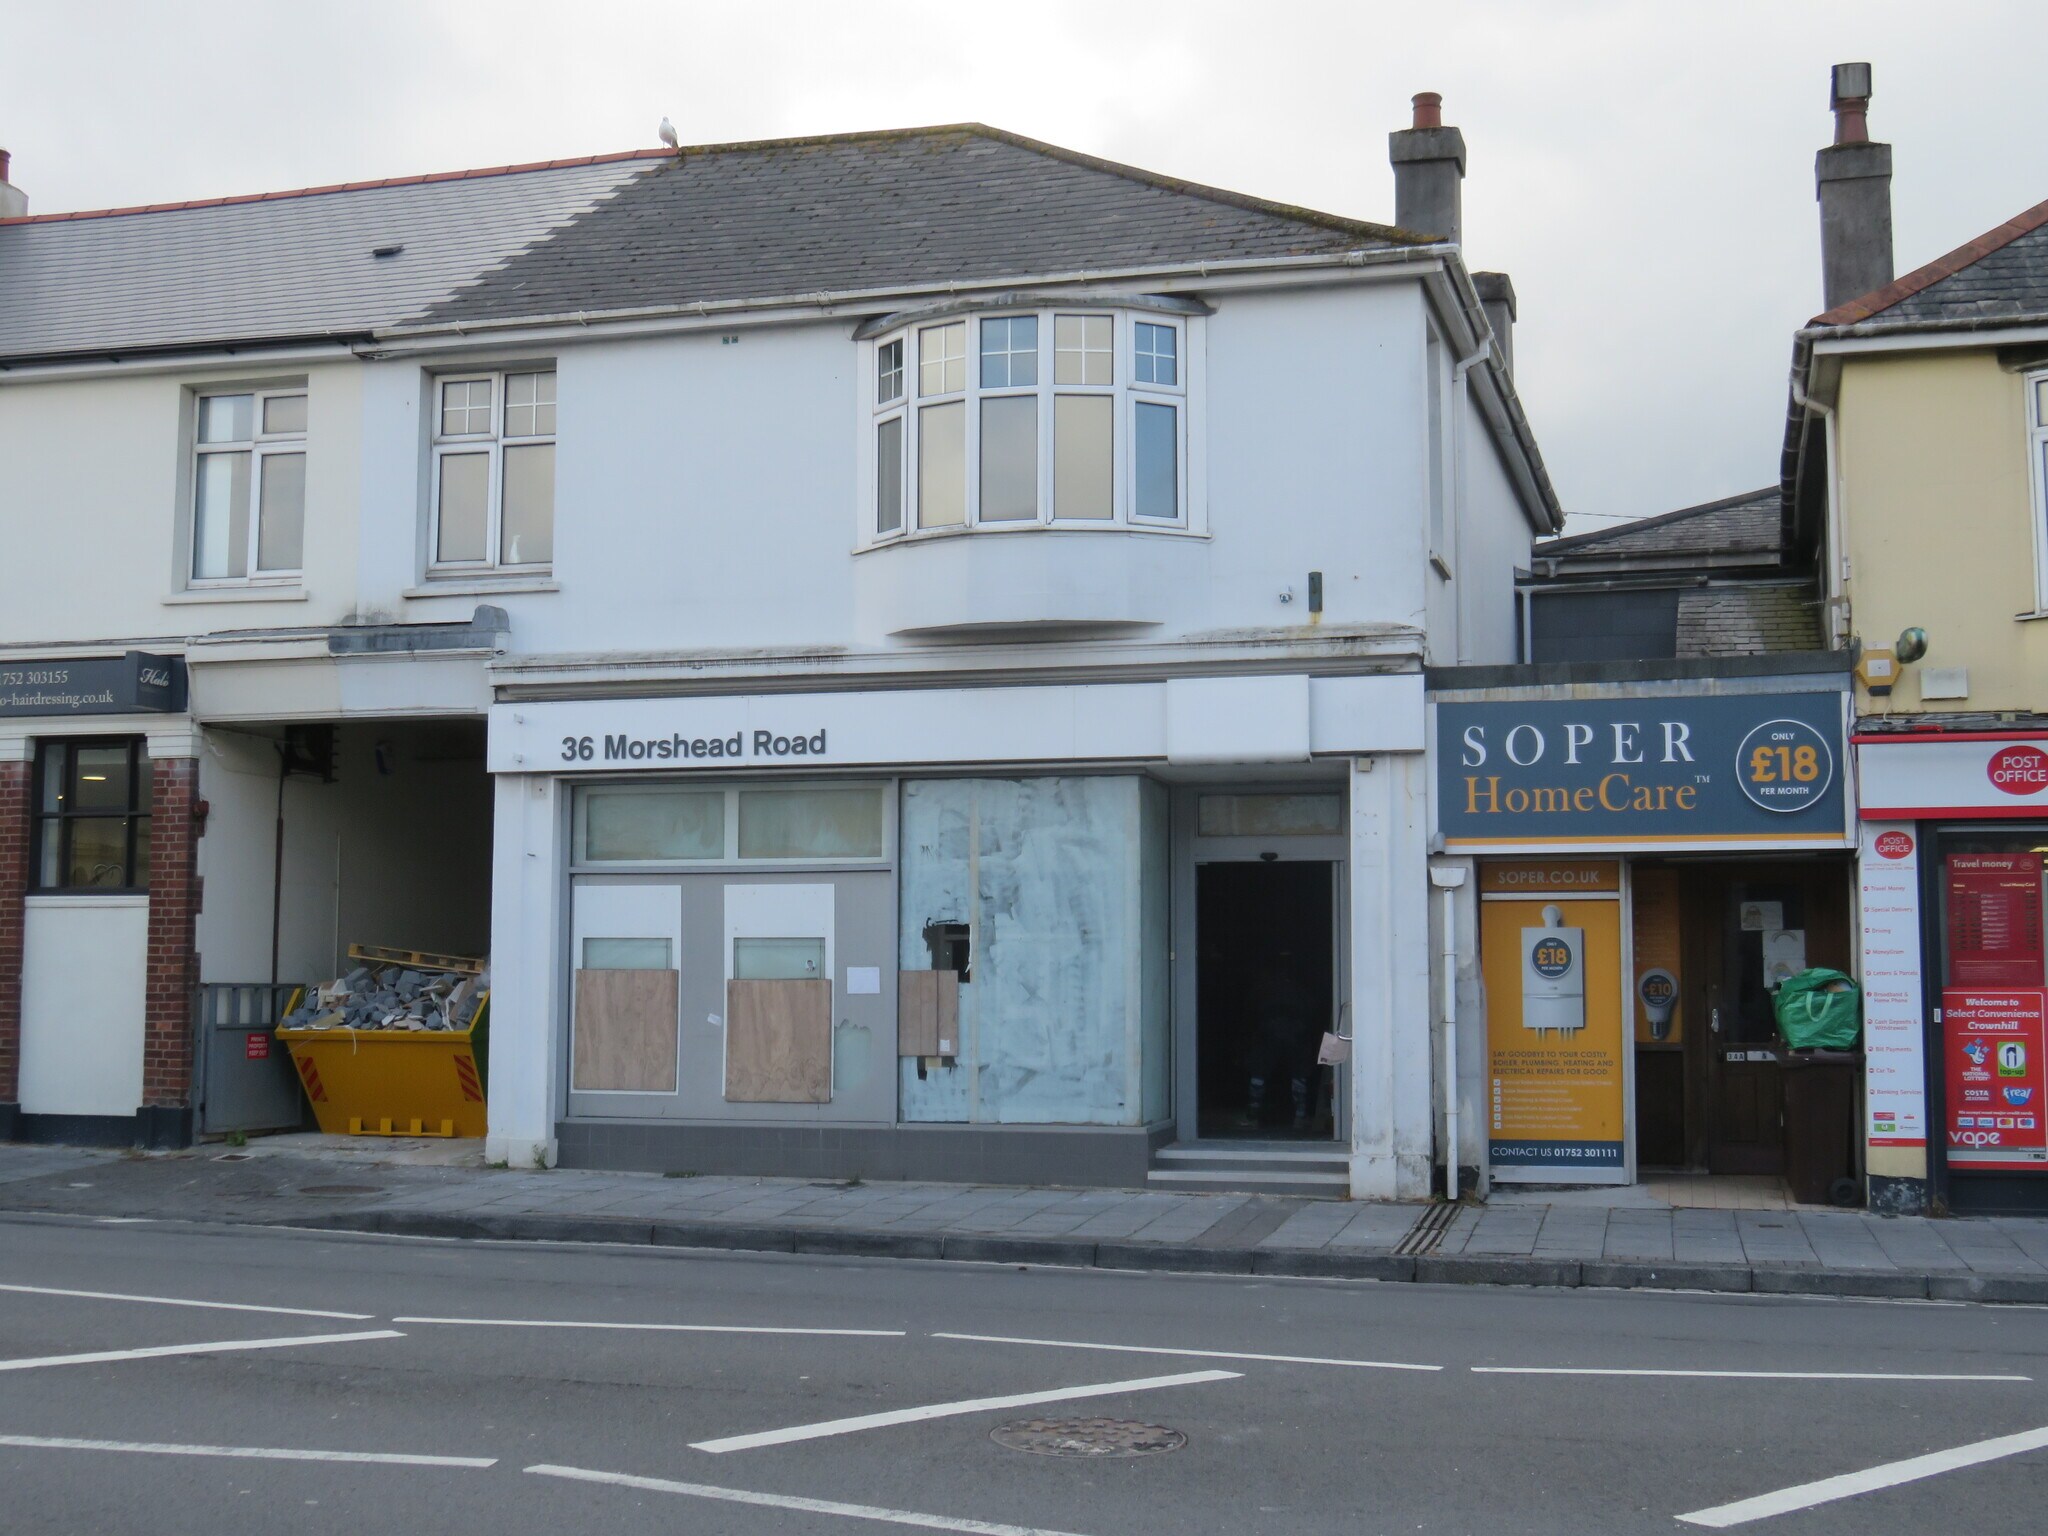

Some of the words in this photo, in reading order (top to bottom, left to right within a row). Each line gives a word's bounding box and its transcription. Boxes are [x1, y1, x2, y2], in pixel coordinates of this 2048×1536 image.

[26, 670, 69, 684] 303155
[139, 668, 169, 687] Halo
[561, 736, 594, 761] 36
[604, 731, 742, 760] Morshead
[753, 729, 826, 756] Road
[1462, 722, 1695, 766] SOPER
[1750, 745, 1818, 782] £18
[2002, 756, 2041, 769] POST
[1993, 769, 2047, 783] OFFICE
[1464, 774, 1697, 813] HomeCare
[1760, 787, 1775, 795] PER
[1777, 787, 1809, 795] MONTH
[1883, 837, 1905, 845] POST
[1878, 845, 1909, 853] OFFICE
[1952, 859, 1980, 868] Travel
[1982, 860, 2013, 870] money
[1498, 870, 1600, 884] SOPER.CO.UK
[1537, 947, 1567, 965] £18
[1965, 998, 2008, 1006] Welcome
[1946, 1009, 1975, 1018] Select
[1977, 1009, 2039, 1018] Convenience
[1967, 1021, 2018, 1030] Crownhill
[1949, 1131, 2000, 1149] vape
[1492, 1147, 1538, 1157] CONTACT
[1540, 1148, 1552, 1157] US
[1554, 1148, 1582, 1157] 01752
[1584, 1149, 1617, 1158] 301111
